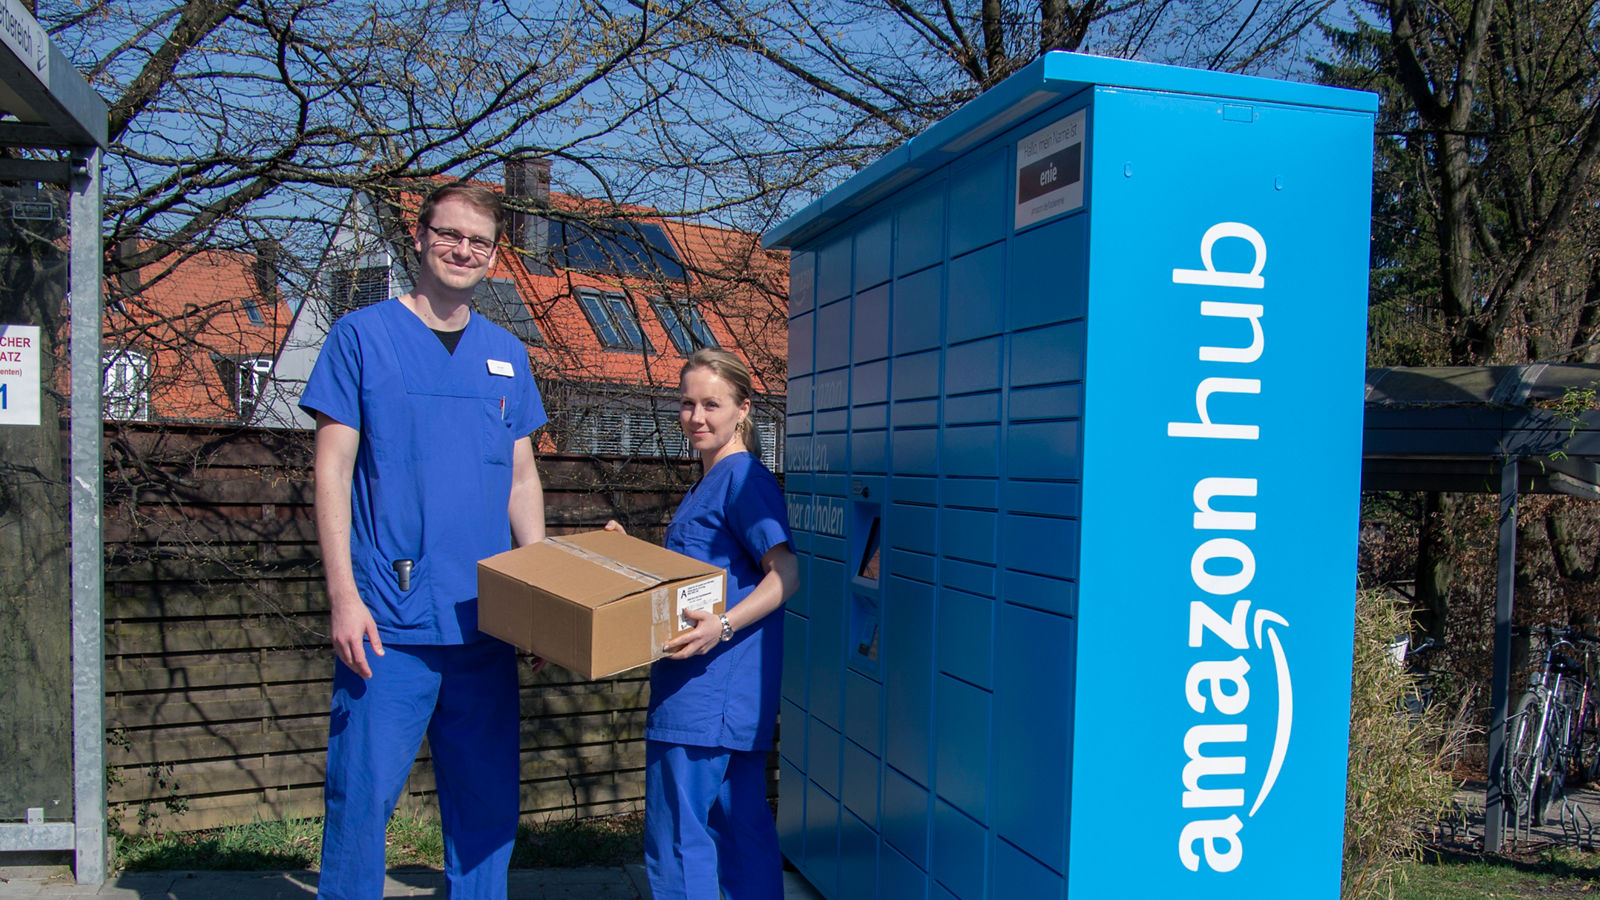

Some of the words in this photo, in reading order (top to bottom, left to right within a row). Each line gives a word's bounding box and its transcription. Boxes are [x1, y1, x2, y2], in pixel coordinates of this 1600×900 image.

[1040, 162, 1058, 186] enie
[1167, 221, 1267, 440] hub
[788, 494, 803, 529] hier
[1179, 477, 1257, 872] amazon
